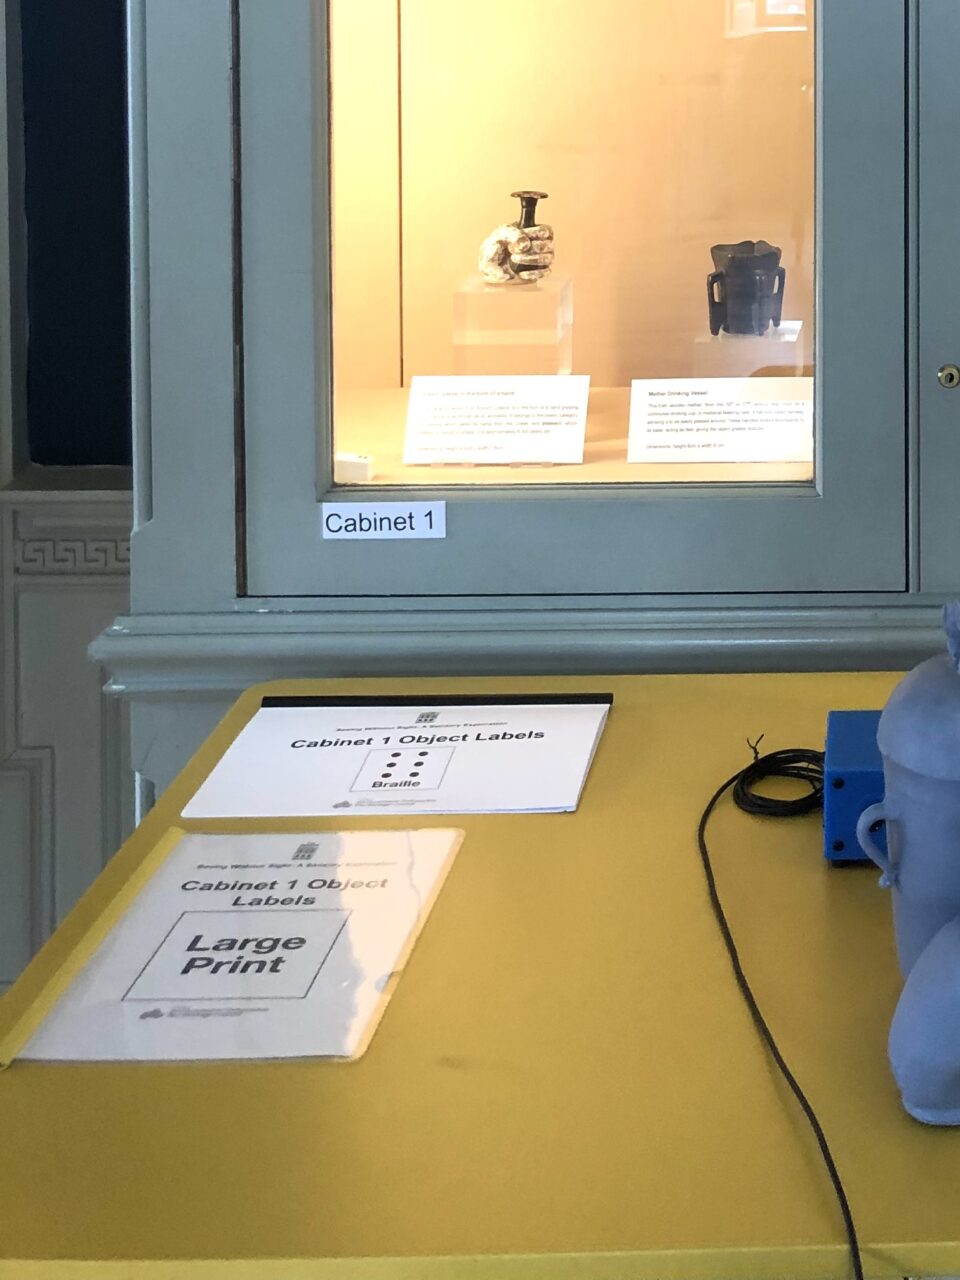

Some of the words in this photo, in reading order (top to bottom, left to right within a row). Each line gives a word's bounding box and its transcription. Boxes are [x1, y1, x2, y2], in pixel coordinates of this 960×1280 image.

[325, 511, 415, 533] Cabinet
[424, 510, 433, 530] 1
[291, 737, 374, 748] Cabinet
[382, 736, 391, 745] 1
[399, 733, 469, 745] Object
[475, 731, 545, 741] Labels
[371, 780, 421, 788] Braille
[181, 879, 279, 891] Cabinet
[287, 879, 299, 890] 1
[307, 878, 389, 891] Object
[232, 895, 316, 906] Labels
[185, 934, 307, 955] Large
[180, 955, 286, 975] Print
